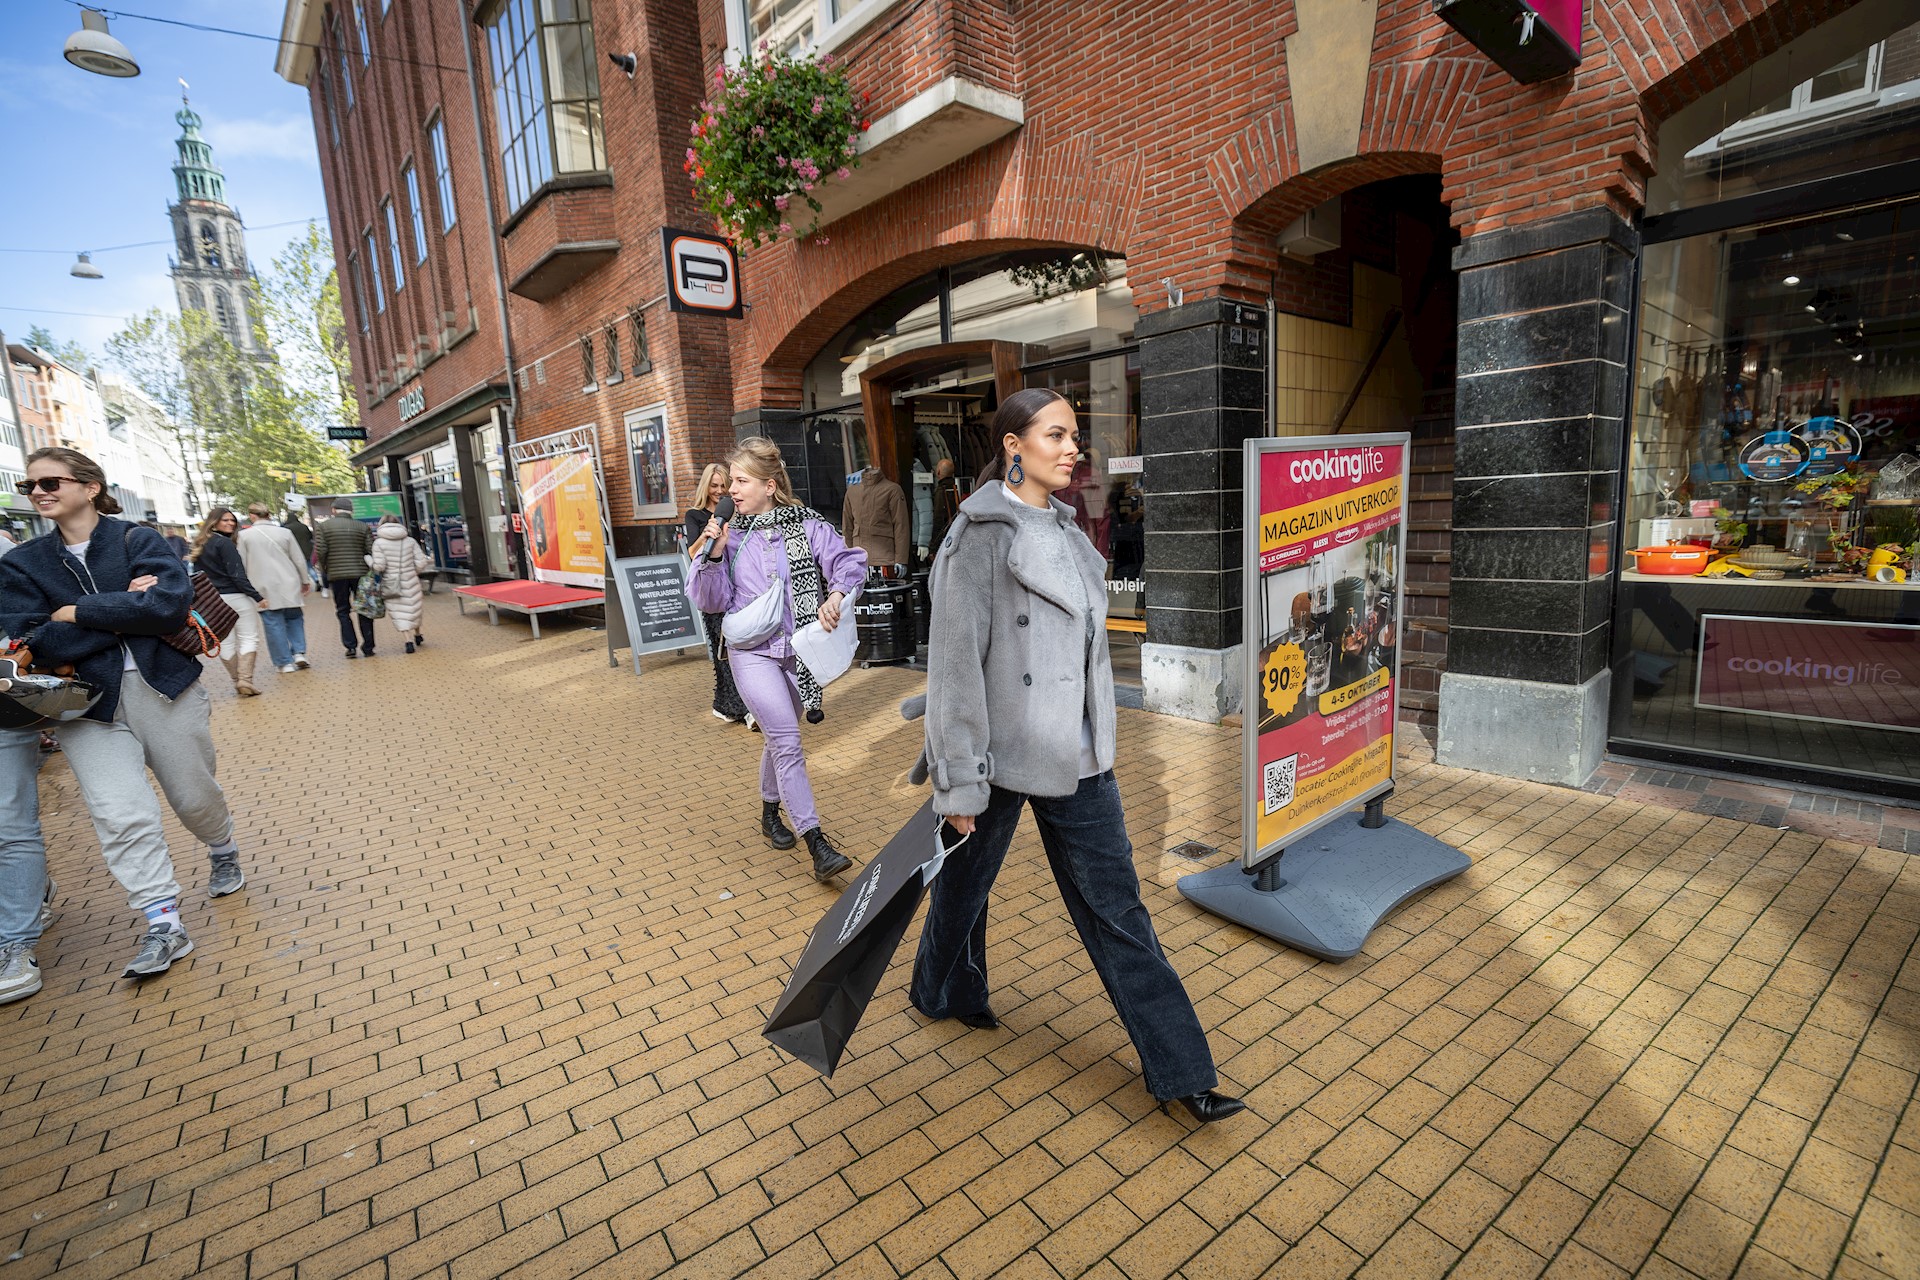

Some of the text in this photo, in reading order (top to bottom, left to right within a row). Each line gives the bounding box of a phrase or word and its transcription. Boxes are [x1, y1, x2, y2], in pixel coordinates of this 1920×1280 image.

[330, 428, 363, 437] DOUGLAS
[1290, 446, 1384, 483] cookinglife
[1264, 485, 1399, 543] MAGAZIJN UITVERKOOP
[1313, 537, 1329, 550] ALESSI
[1267, 547, 1303, 563] LE CREUSET
[635, 569, 652, 577] GROOT
[661, 578, 680, 586] HEREN
[637, 588, 681, 600] WINTERJASSEN
[1291, 653, 1299, 661] TO
[1727, 656, 1902, 686] cookinglife
[1288, 682, 1299, 690] OFF
[1331, 674, 1381, 705] 4-5 OKTOBER
[1363, 741, 1388, 763] Magazijn
[1359, 759, 1388, 782] Groningen
